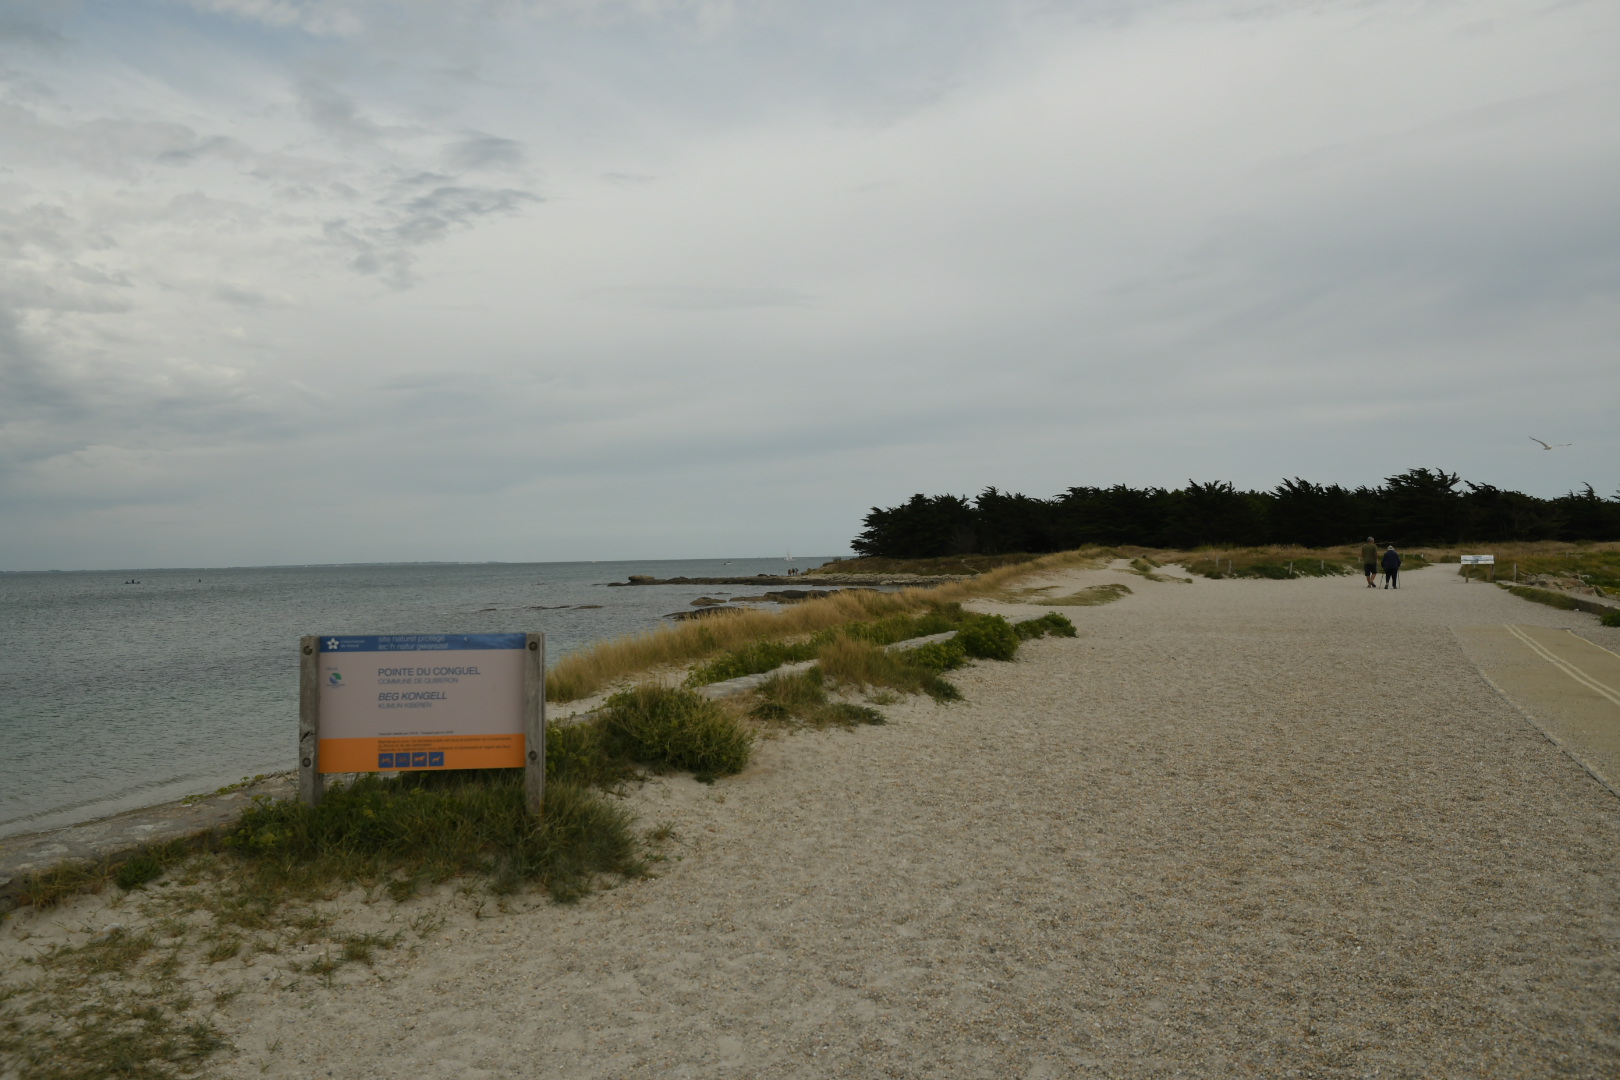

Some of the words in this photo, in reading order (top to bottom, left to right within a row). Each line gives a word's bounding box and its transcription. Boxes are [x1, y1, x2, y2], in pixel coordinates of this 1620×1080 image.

[378, 668, 414, 676] POINTE
[416, 667, 431, 676] DU
[433, 666, 481, 675] CONGUEL
[378, 692, 400, 701] BEG
[401, 691, 448, 700] KONGELL
